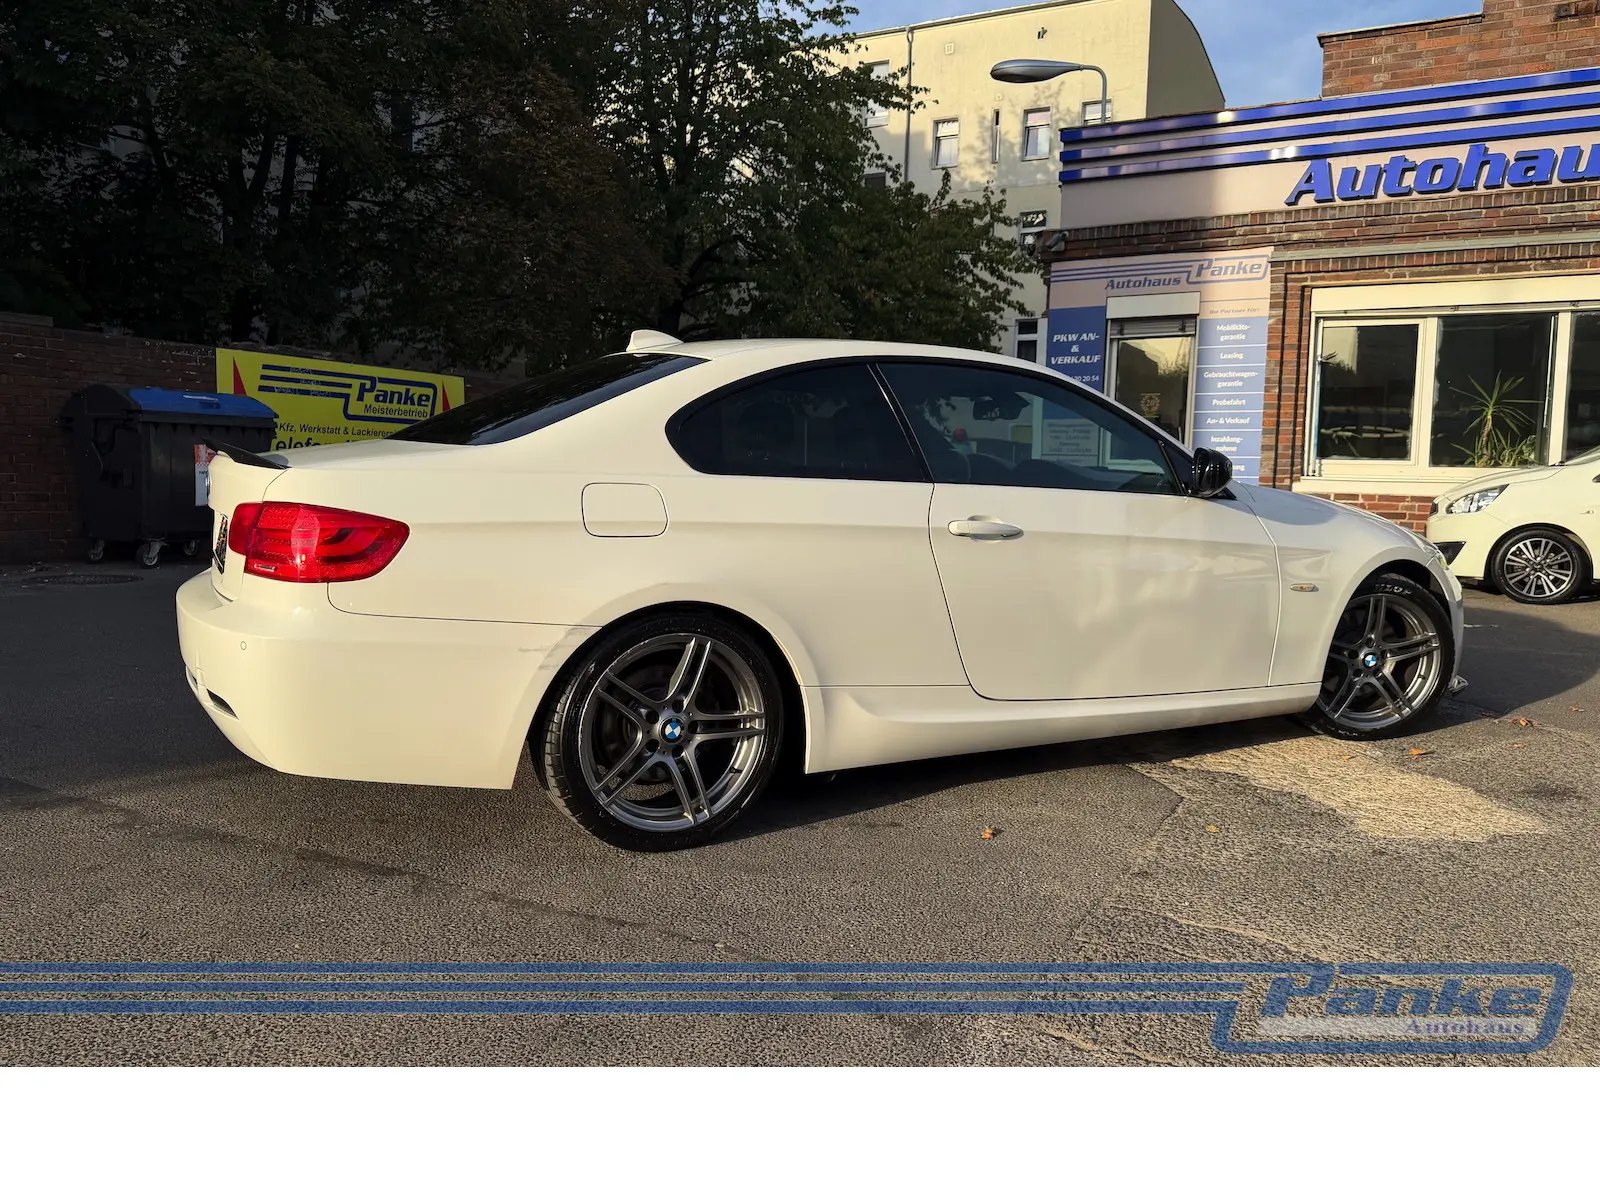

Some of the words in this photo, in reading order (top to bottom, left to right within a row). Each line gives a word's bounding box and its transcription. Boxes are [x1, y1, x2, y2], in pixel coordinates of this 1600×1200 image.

[1284, 143, 1600, 206] Autohau
[1196, 259, 1263, 278] Panke
[1105, 277, 1181, 290] Autohaus
[1053, 333, 1079, 342] PKW
[1079, 332, 1100, 341] AN-
[1220, 333, 1246, 342] garantie
[1071, 344, 1079, 352] &
[1051, 354, 1101, 365] VERKAUF
[1220, 352, 1244, 360] Leasing
[1217, 380, 1243, 388] garantie
[356, 376, 431, 407] Panke
[1212, 398, 1246, 406] Probefahrt
[363, 403, 429, 419] Meisterbetrieb
[1225, 416, 1251, 424] Verkauf
[279, 422, 297, 434] Kfz,
[299, 423, 341, 435] Werkstatt
[343, 426, 349, 435] &
[1210, 435, 1244, 444] Inzahlung-
